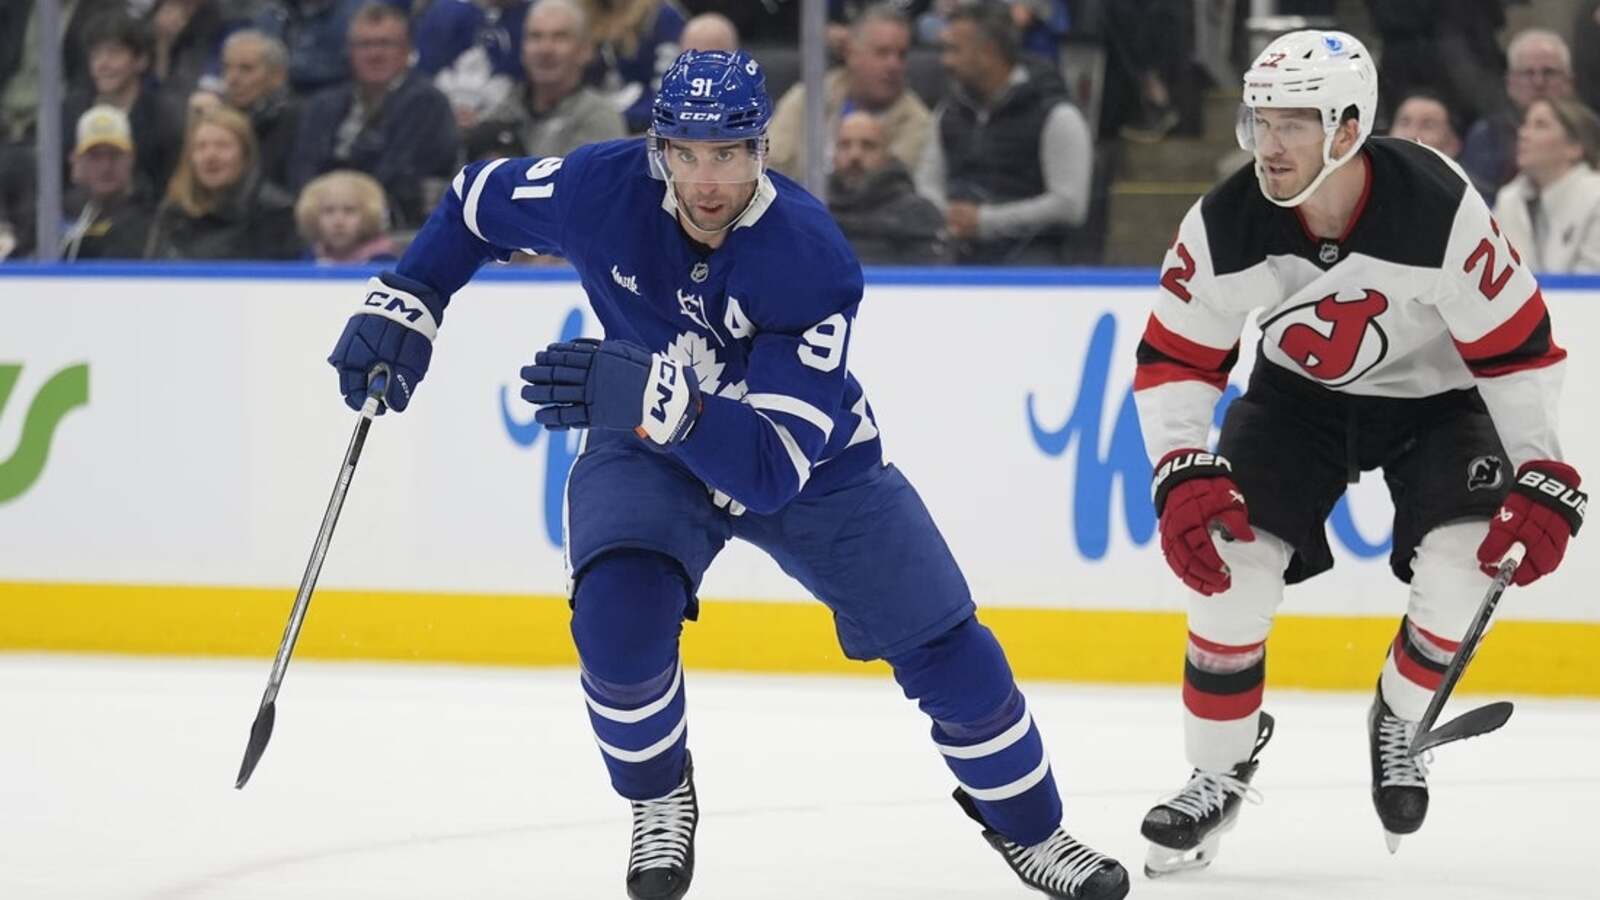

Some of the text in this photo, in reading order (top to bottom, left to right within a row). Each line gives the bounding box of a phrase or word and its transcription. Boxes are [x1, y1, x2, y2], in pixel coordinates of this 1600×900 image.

[690, 77, 713, 97] 91
[680, 111, 721, 121] CCM
[1463, 213, 1521, 301] 2
[364, 290, 424, 323] CM
[797, 313, 856, 379] 9
[650, 358, 677, 424] CM
